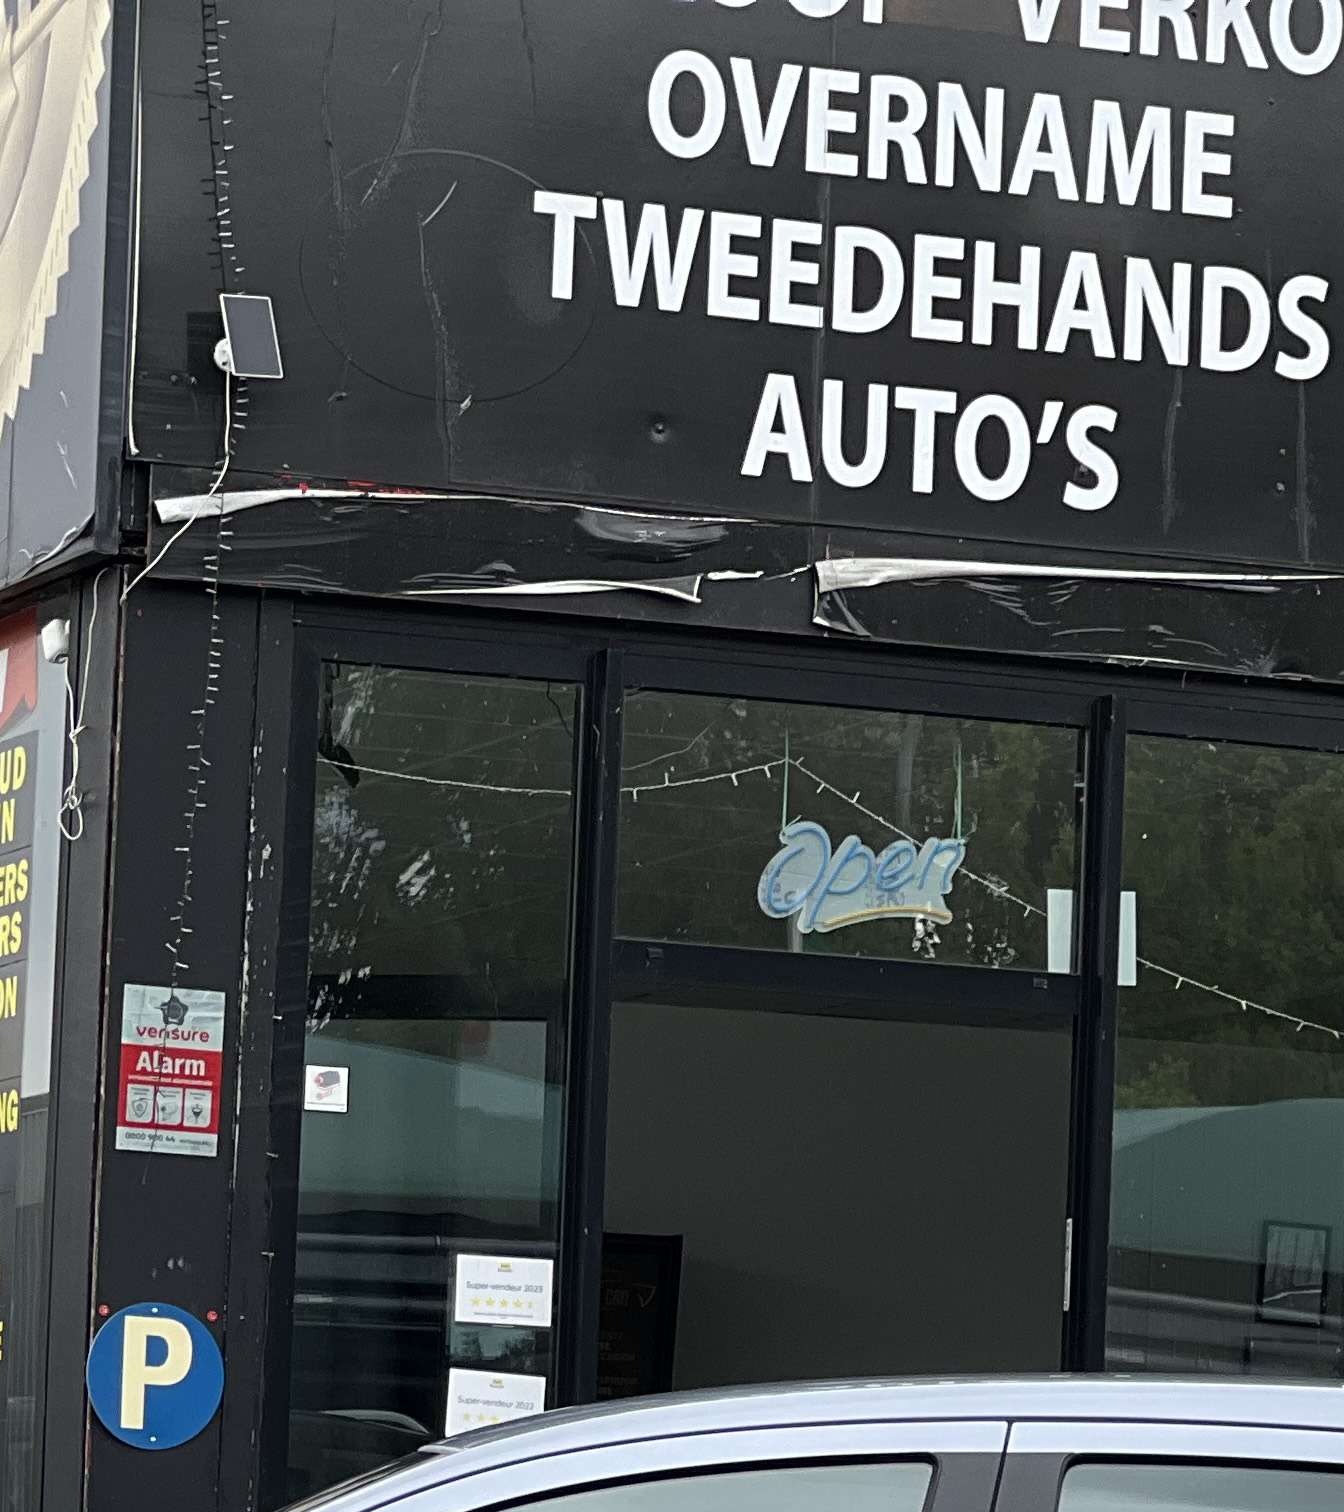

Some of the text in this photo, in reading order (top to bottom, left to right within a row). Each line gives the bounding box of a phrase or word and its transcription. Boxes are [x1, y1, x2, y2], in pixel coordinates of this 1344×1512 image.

[647, 49, 1235, 218] OVERNAME
[533, 190, 1331, 381] TWEEDEHANDS
[765, 822, 965, 932] Open
[135, 1051, 206, 1076] Alarm
[120, 1315, 193, 1431] P
